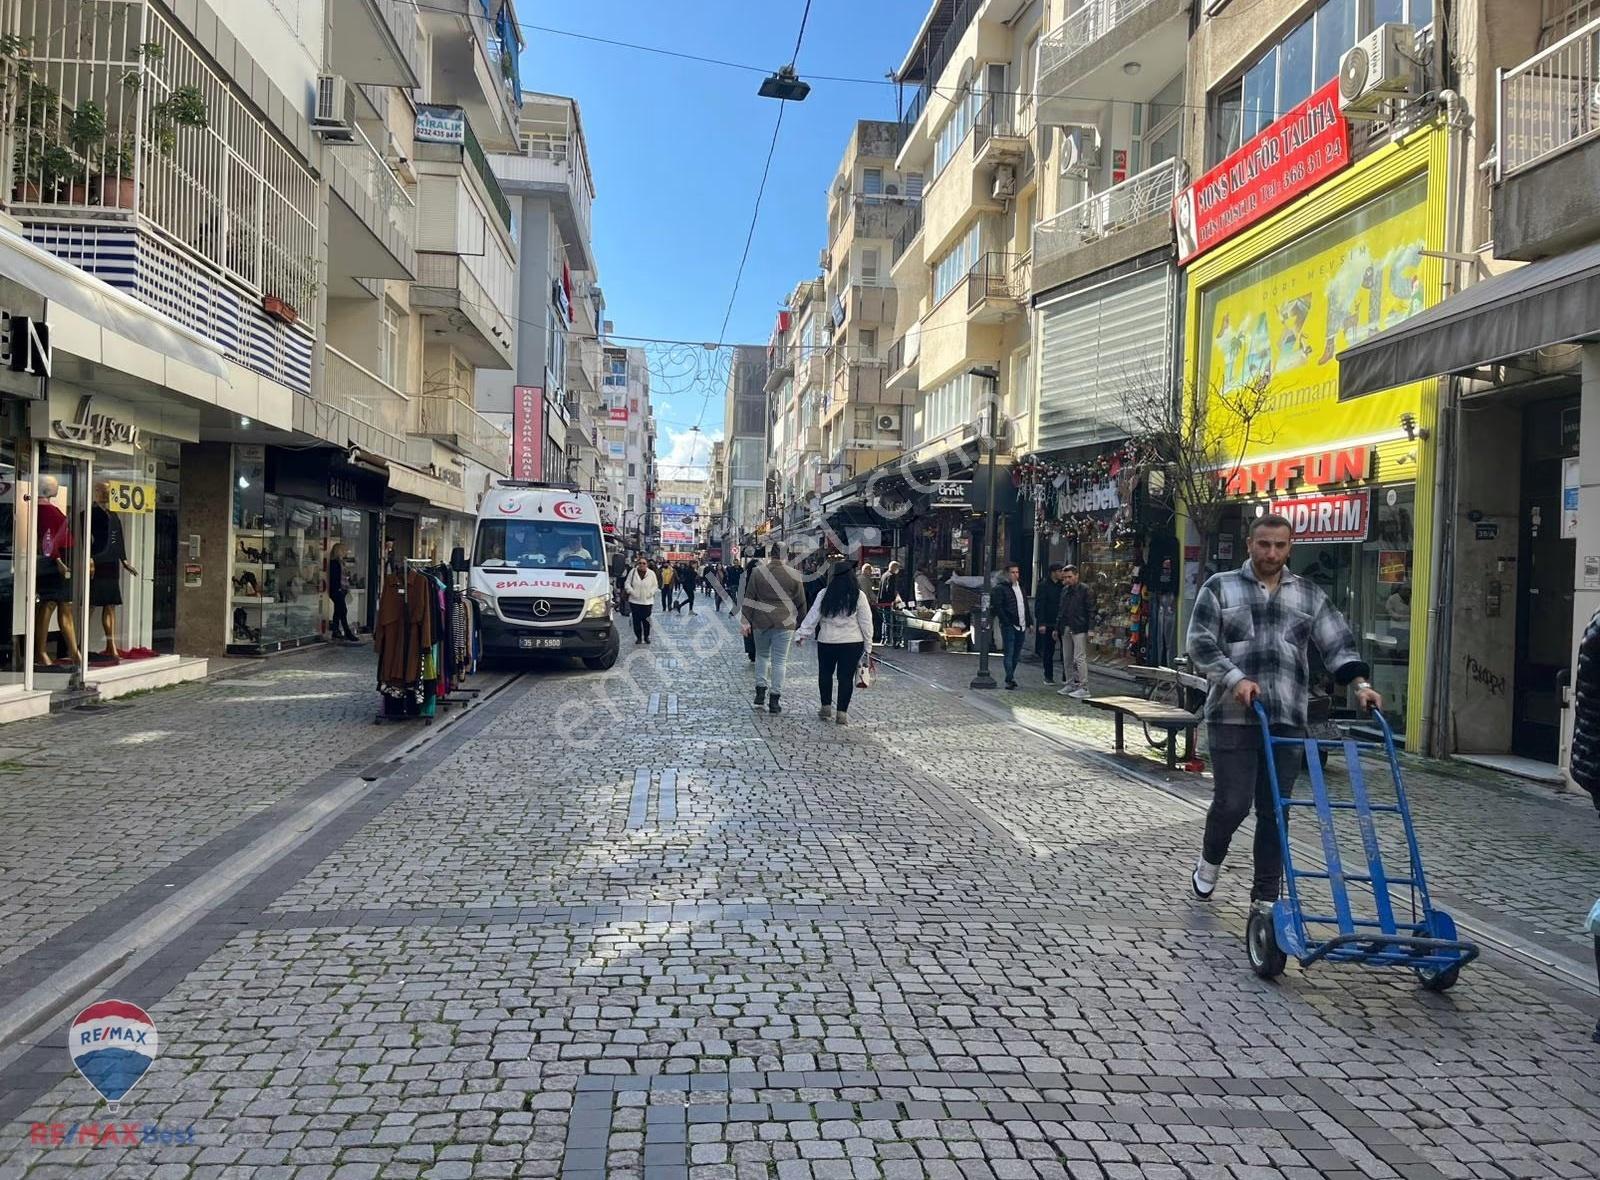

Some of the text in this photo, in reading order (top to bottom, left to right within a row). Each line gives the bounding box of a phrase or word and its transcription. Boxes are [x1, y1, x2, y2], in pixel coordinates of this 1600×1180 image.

[1325, 138, 1342, 163] 24
[1229, 137, 1280, 194] KUAFÖR
[1217, 445, 1370, 497] TAYFUN
[111, 485, 145, 510] %50
[561, 506, 583, 515] 112
